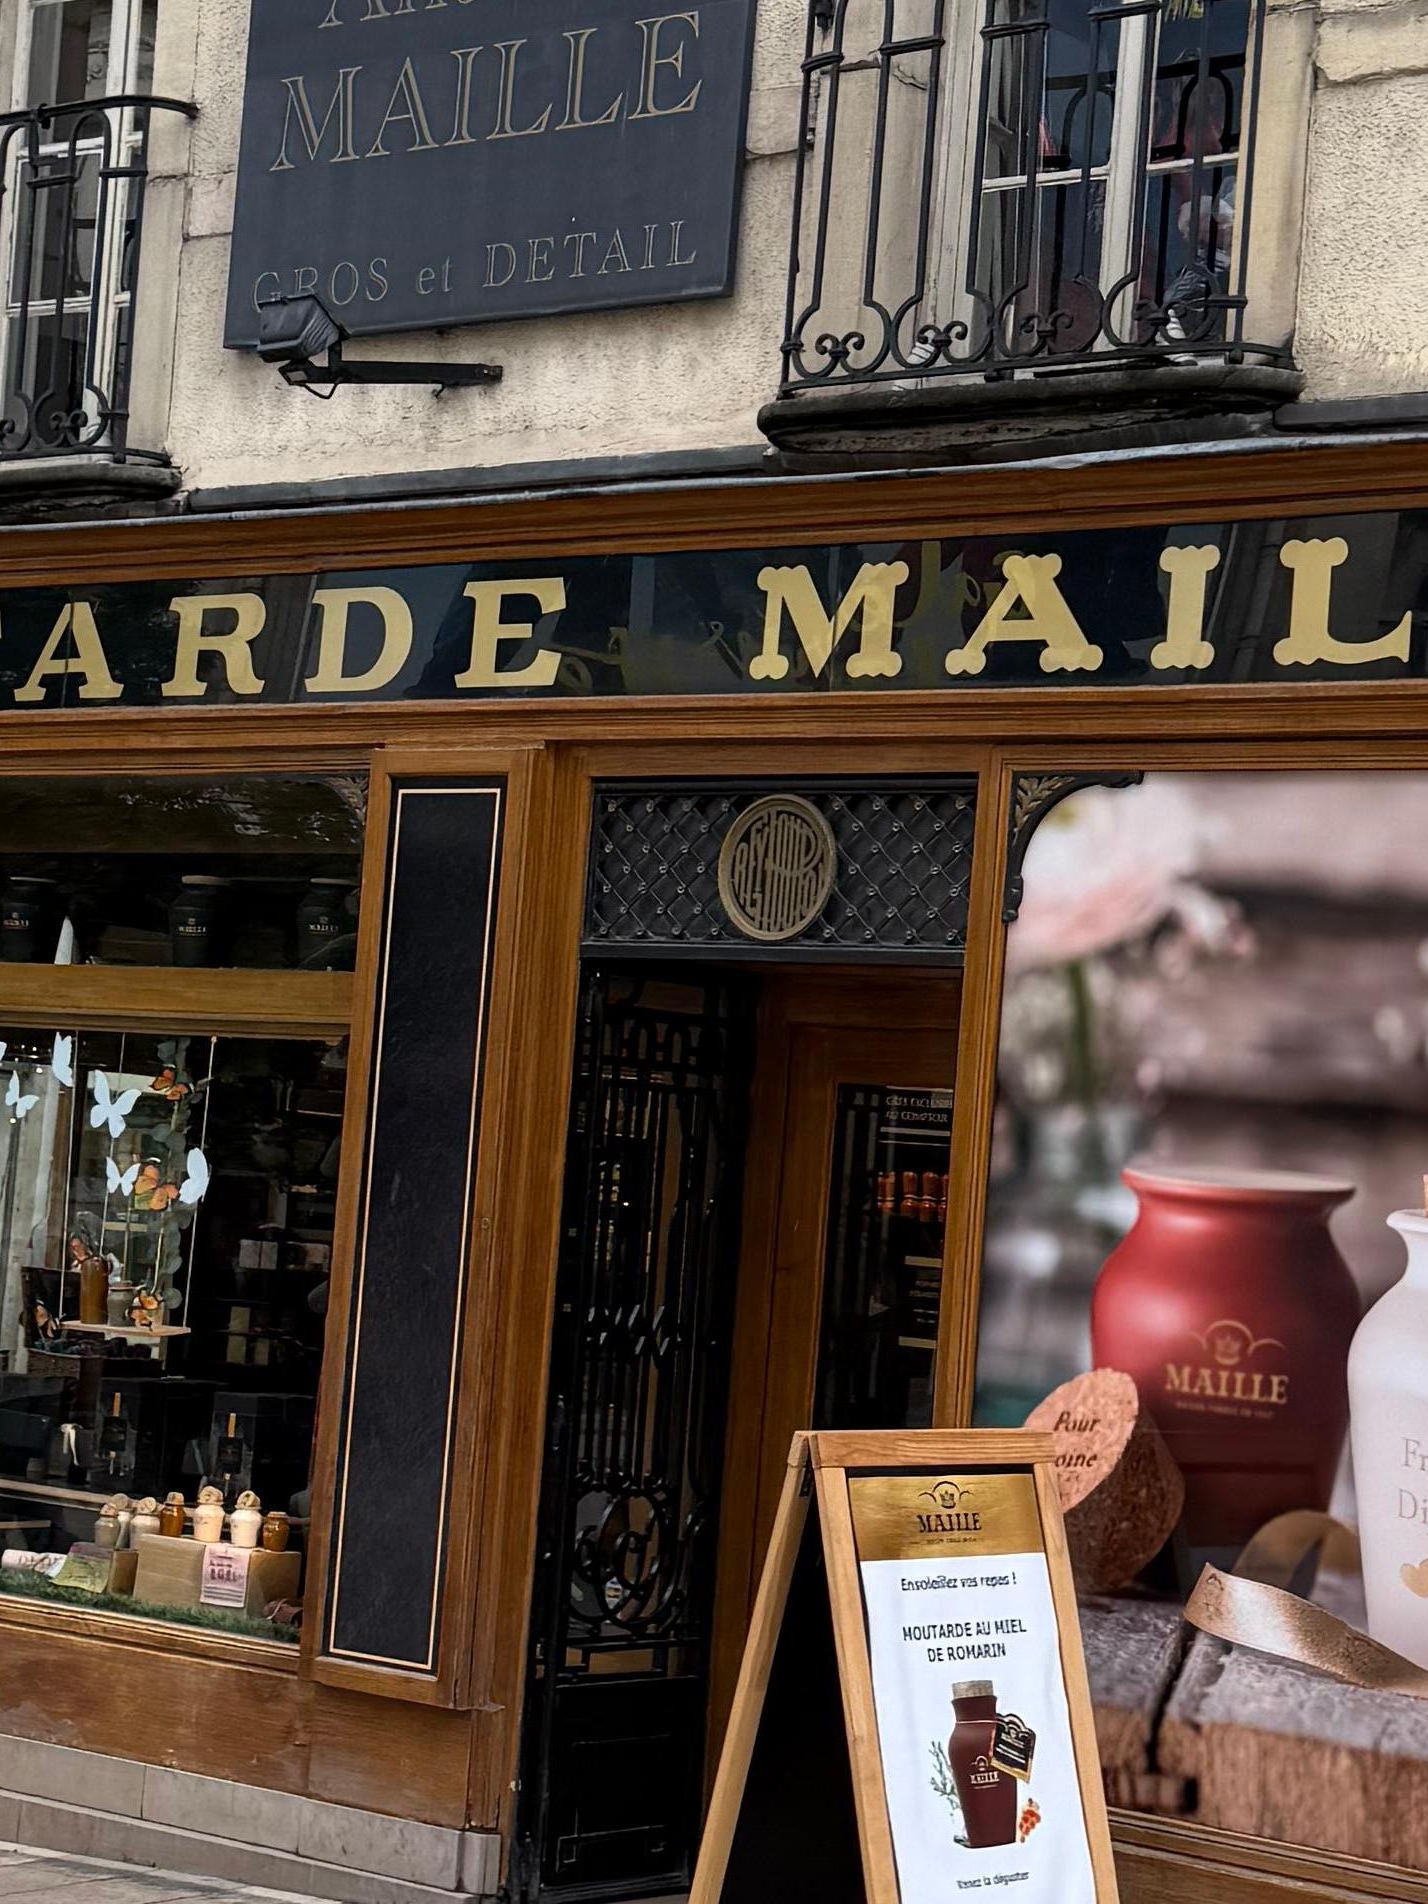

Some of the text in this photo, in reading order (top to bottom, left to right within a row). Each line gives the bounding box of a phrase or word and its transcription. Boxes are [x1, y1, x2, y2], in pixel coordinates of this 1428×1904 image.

[269, 11, 703, 171] MAILLE
[416, 256, 454, 295] et
[482, 220, 698, 289] DETAIL
[1164, 1362, 1290, 1405] MAILLE
[1053, 1410, 1101, 1433] Pour
[1054, 1448, 1099, 1469] oine
[916, 1512, 983, 1533] MAILLE
[902, 1618, 1028, 1641] MOUTARDE AU MIEL
[927, 1642, 1006, 1663] DE ROMARIN
